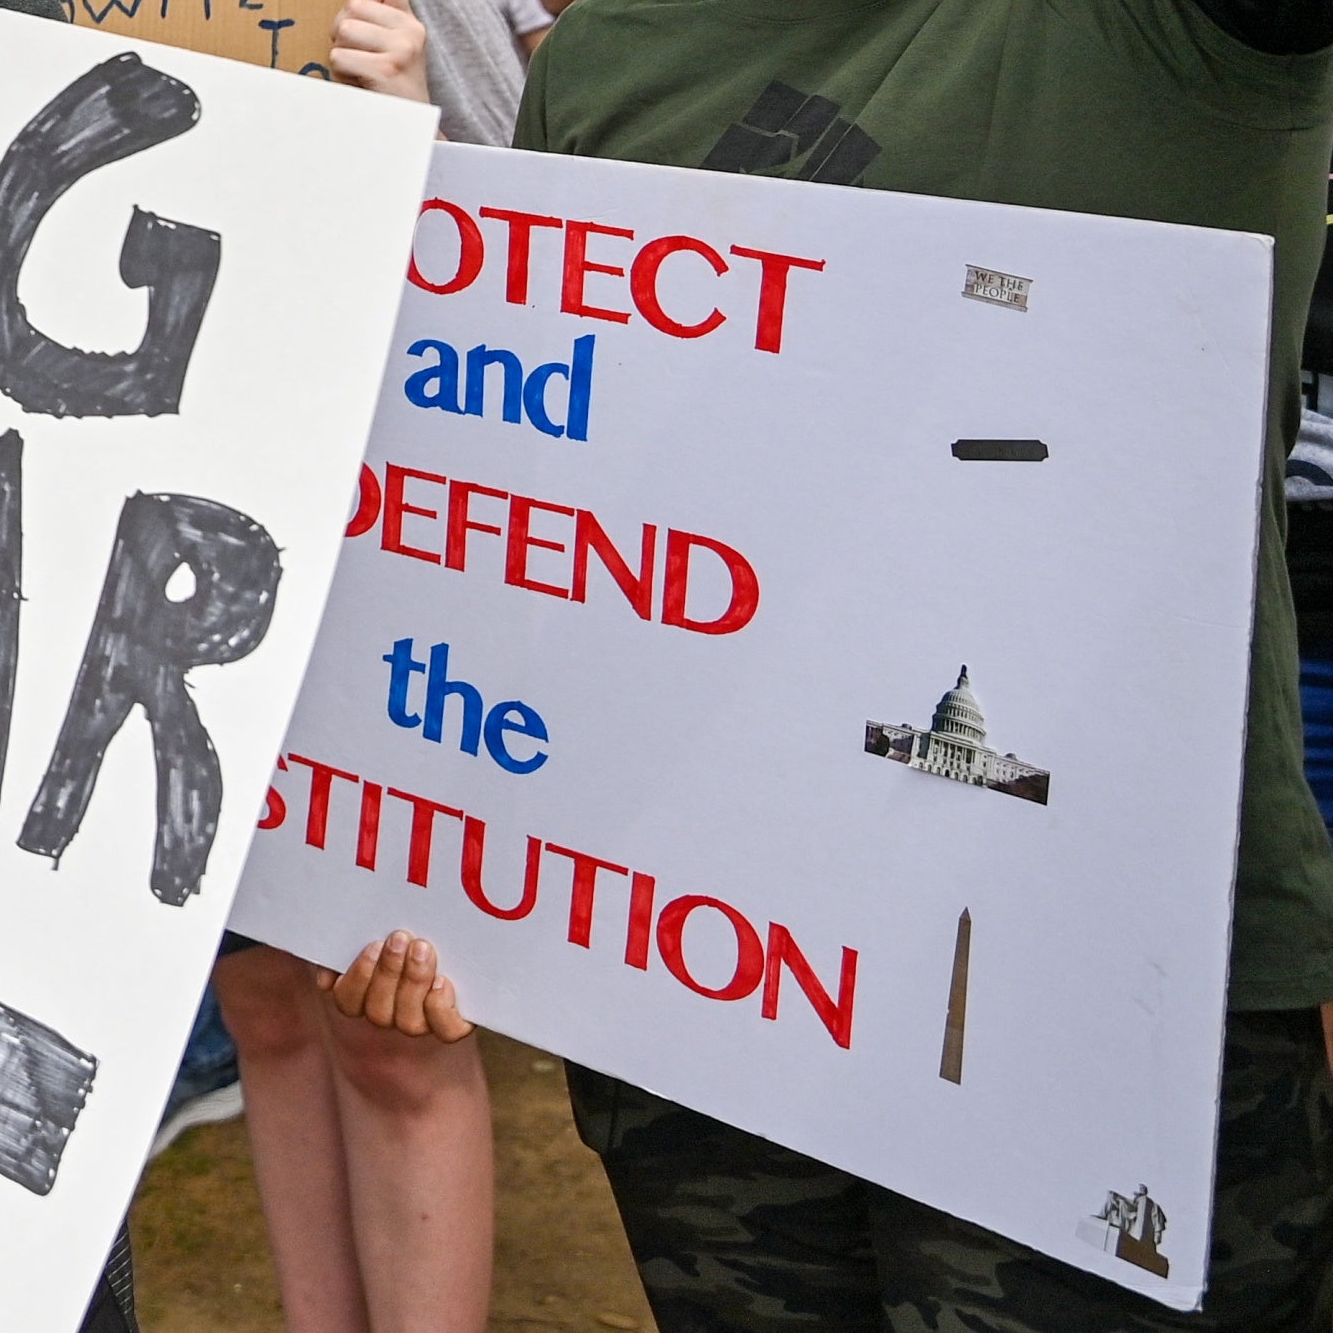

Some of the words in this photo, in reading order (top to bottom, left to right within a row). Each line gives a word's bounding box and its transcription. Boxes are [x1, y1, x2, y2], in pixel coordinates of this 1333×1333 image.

[973, 282, 1021, 304] PEOPLE
[974, 270, 995, 285] WE
[997, 276, 1024, 292] THE
[404, 334, 596, 441] and
[383, 638, 549, 774] the
